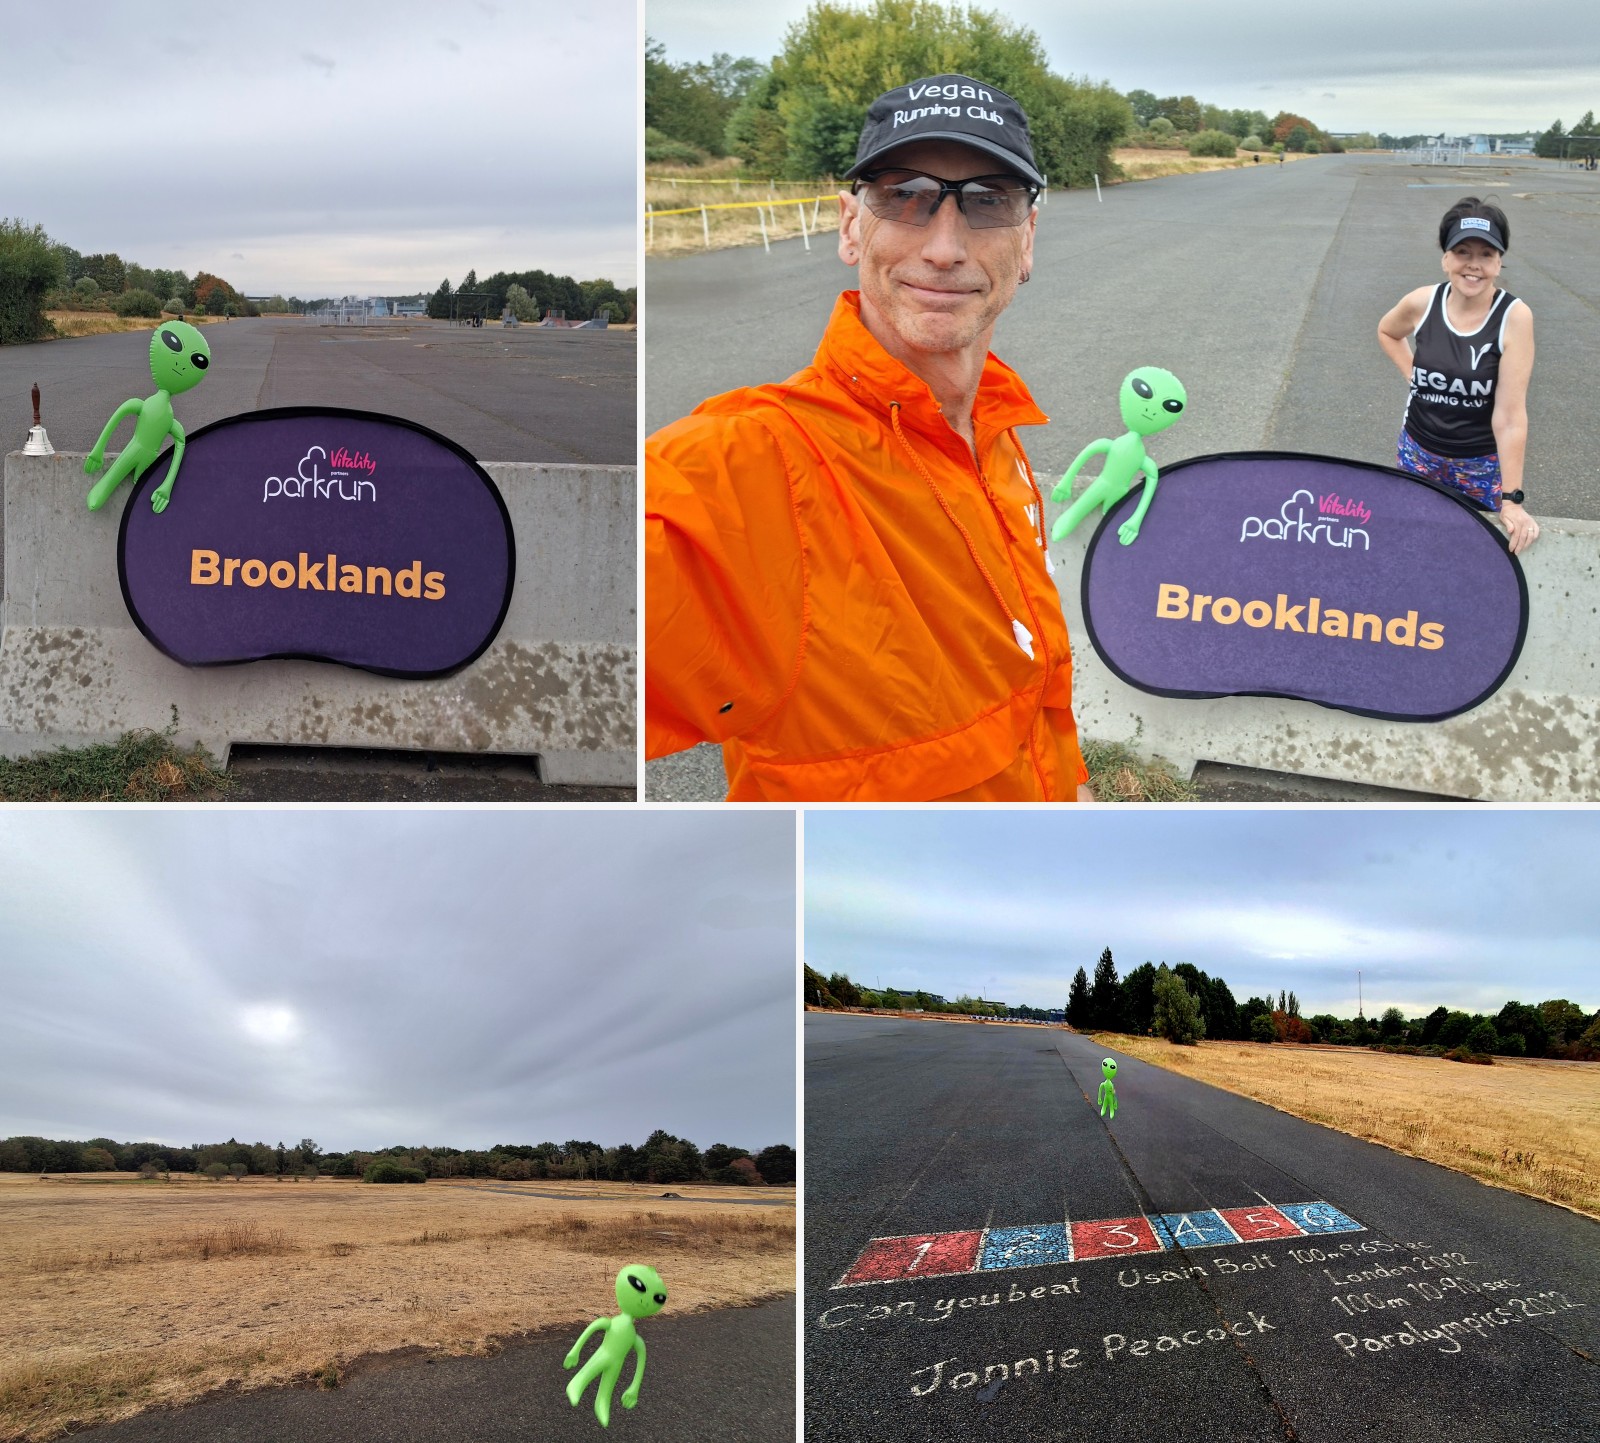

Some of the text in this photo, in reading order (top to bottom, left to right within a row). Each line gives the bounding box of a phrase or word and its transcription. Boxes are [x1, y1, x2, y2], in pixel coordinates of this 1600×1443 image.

[893, 103, 1004, 128] Running Club
[908, 84, 993, 102] Vegan
[262, 446, 376, 502] parkrun
[330, 446, 377, 476] Vitality
[1240, 489, 1370, 551] parkrun
[1319, 492, 1372, 525] Vitality
[190, 549, 446, 600] Brooklands
[1156, 583, 1445, 650] Brooklands
[907, 1207, 1336, 1271] 1 2 3 4 5 6
[818, 1301, 915, 1328] Can
[918, 1293, 1000, 1321] you
[1007, 1276, 1082, 1303] beat
[1116, 1264, 1210, 1288] Usain
[1212, 1252, 1278, 1275] Bolt
[1322, 1251, 1478, 1286] London 2012
[1331, 1292, 1412, 1317] 100m
[1482, 1278, 1521, 1291] sec
[1332, 1290, 1585, 1358] Paralympics 2012
[910, 1311, 1276, 1397] Jonnie Peacock
